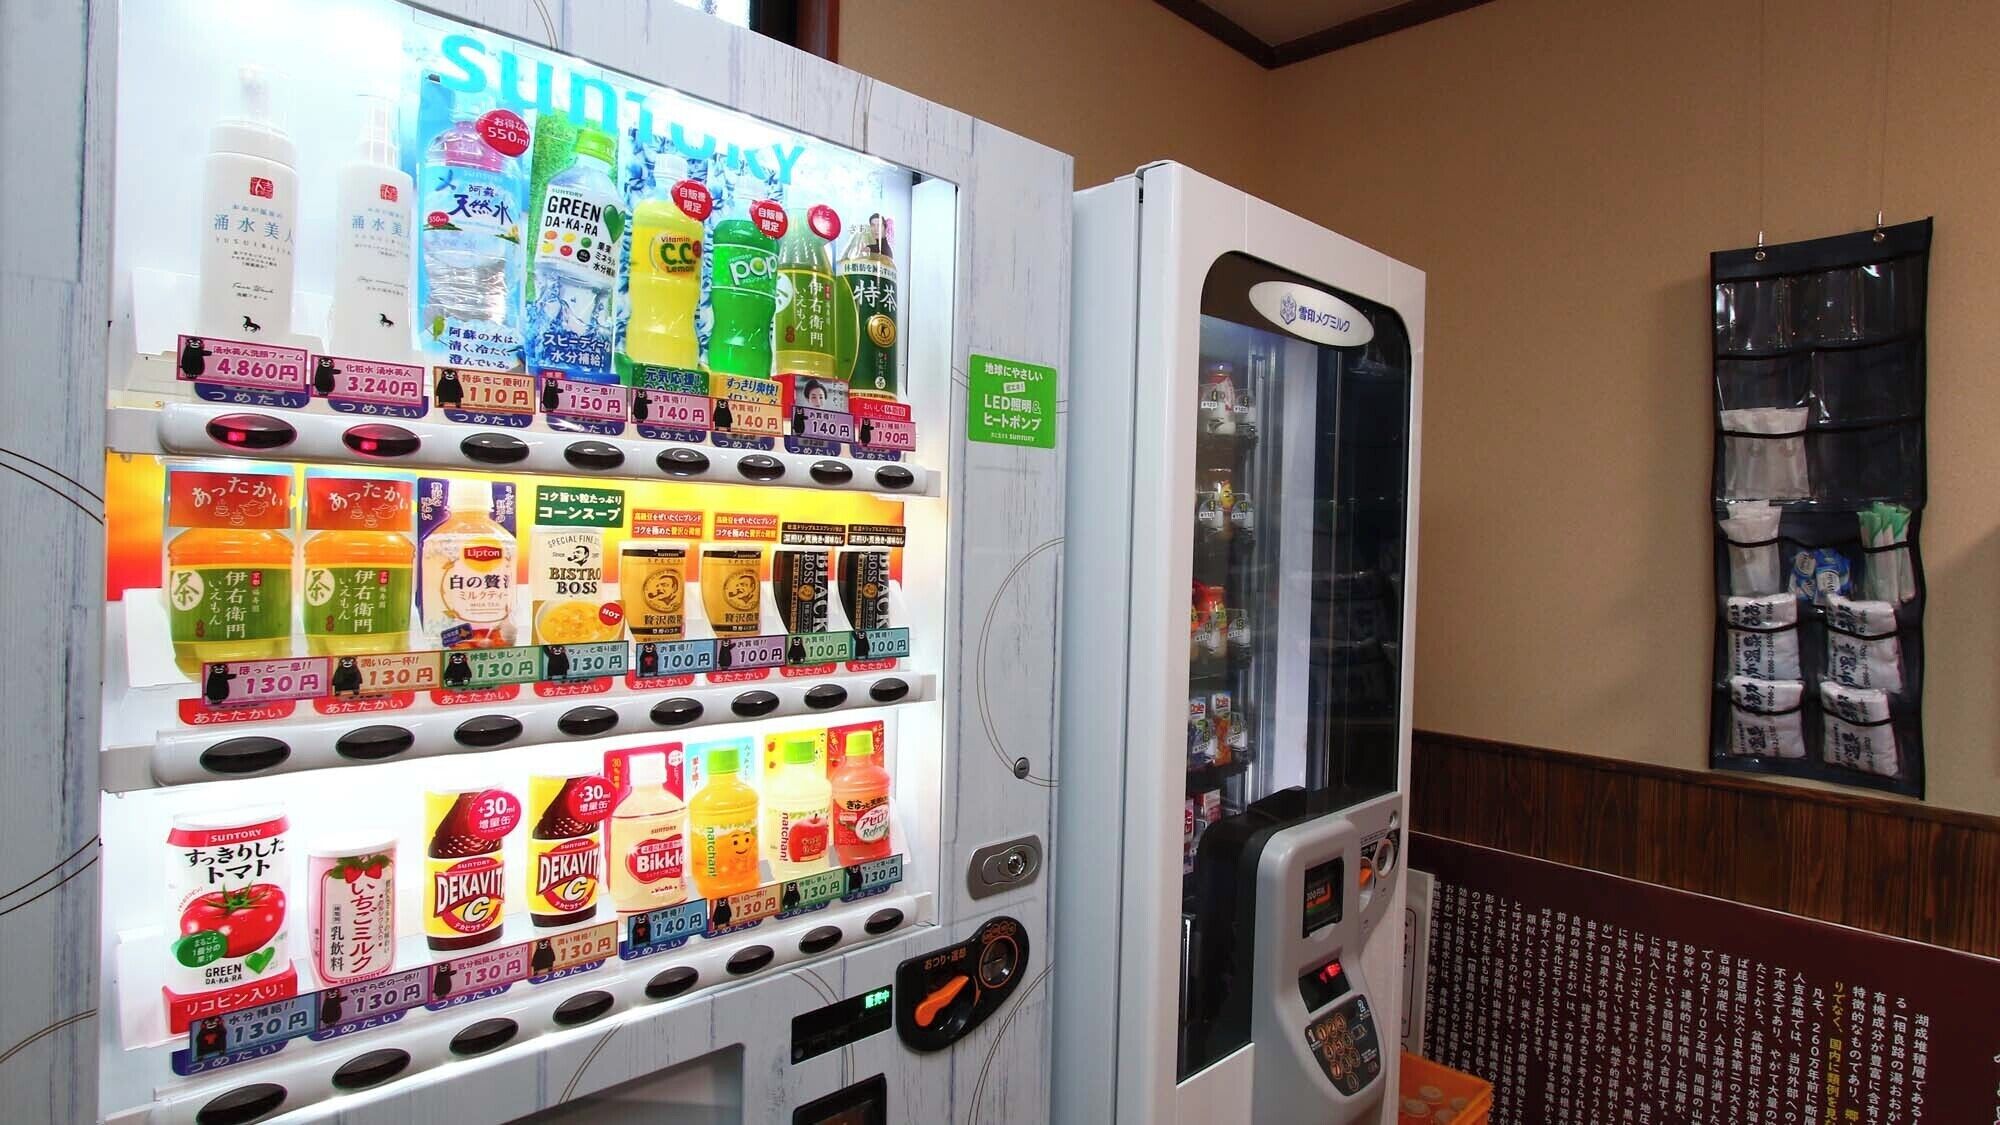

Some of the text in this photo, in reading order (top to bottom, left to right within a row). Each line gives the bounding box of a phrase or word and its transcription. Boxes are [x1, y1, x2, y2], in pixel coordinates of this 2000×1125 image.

[487, 126, 528, 147] 550ml
[448, 194, 513, 225] 天然水
[547, 195, 602, 223] GREEN
[683, 202, 703, 214] 限定
[758, 206, 784, 223] 自販機
[761, 220, 780, 233] 限定
[854, 279, 897, 313] 特茶
[795, 287, 807, 333] いえもん
[808, 278, 823, 348] 伊右衛門
[1298, 305, 1350, 333] 雪印メグミルク
[984, 361, 1043, 382] 地球にやさしい
[208, 391, 297, 407] つめたい
[469, 387, 529, 405] 110円
[570, 394, 621, 413] 150円
[342, 402, 417, 418] つめたい
[455, 412, 524, 427] つめたい
[658, 405, 705, 423] 140円
[736, 414, 778, 430] 140円
[812, 421, 850, 437] 140円
[984, 412, 1042, 431] ヒートポンプ
[645, 430, 699, 442] つめたい
[719, 439, 769, 450] つめたい
[878, 431, 909, 445] 190円
[791, 446, 836, 455] つめたい
[855, 451, 896, 460] つめたい
[192, 476, 283, 508] あったかい
[329, 481, 408, 512] あったかい
[539, 491, 622, 505] コク旨い粒たっぷり
[539, 505, 621, 521] コーンスープ
[547, 535, 577, 549] SPECIAL
[467, 549, 500, 559] Lipton
[549, 567, 600, 580] BISTRO
[803, 551, 815, 584] BOSS
[868, 554, 878, 583] BOSS
[173, 571, 200, 606] 茶
[307, 567, 331, 601] 茶
[557, 581, 598, 594] BOSS
[208, 579, 222, 627] いえもん
[225, 570, 248, 639] 伊右衛門
[339, 577, 351, 621] いえもん
[353, 569, 376, 634] 伊右衛門
[602, 609, 620, 620] HOT
[740, 648, 783, 662] 100円
[809, 643, 848, 658] 100円
[871, 640, 906, 653] 100円
[476, 660, 533, 678] 130円
[572, 655, 622, 672] 130円
[663, 652, 710, 669] 100円
[851, 662, 892, 671] あたたかい
[368, 667, 433, 686] 130円
[714, 671, 764, 681] あたたかい
[786, 667, 832, 677] あたたかい
[246, 673, 319, 694] 130円
[543, 684, 605, 697] あたたかい
[633, 677, 688, 688] あたたかい
[326, 699, 404, 714] あたたかい
[442, 692, 511, 704] あたたかい
[193, 707, 285, 724] あたたかい
[210, 828, 263, 843] SUNTORY
[560, 840, 590, 850] SUNTORY
[779, 812, 789, 862] natchan!
[185, 837, 285, 866] すっきりした
[706, 826, 717, 878] natchan!
[208, 859, 271, 884] トマト
[456, 859, 491, 870] SUNTORY
[865, 866, 898, 884] 130円
[563, 876, 588, 901] C
[803, 881, 840, 900] 130円
[463, 896, 490, 923] C
[734, 899, 776, 918] 130円
[350, 882, 376, 974] いちごミルク
[655, 914, 702, 937] 140円
[710, 919, 758, 938] つめたい
[330, 925, 345, 972] 乳飲料
[560, 937, 611, 962] 130円
[629, 940, 682, 960] つめたい
[205, 963, 242, 978] GREEN
[464, 959, 521, 986] 130円
[540, 961, 598, 982] つめたい
[186, 983, 284, 1014] リコピン入り!
[355, 983, 421, 1014] 130円
[438, 986, 504, 1010] つめたい
[234, 1010, 307, 1044] 130円
[320, 1013, 398, 1039] つめたい
[187, 1043, 277, 1074] つめたい
